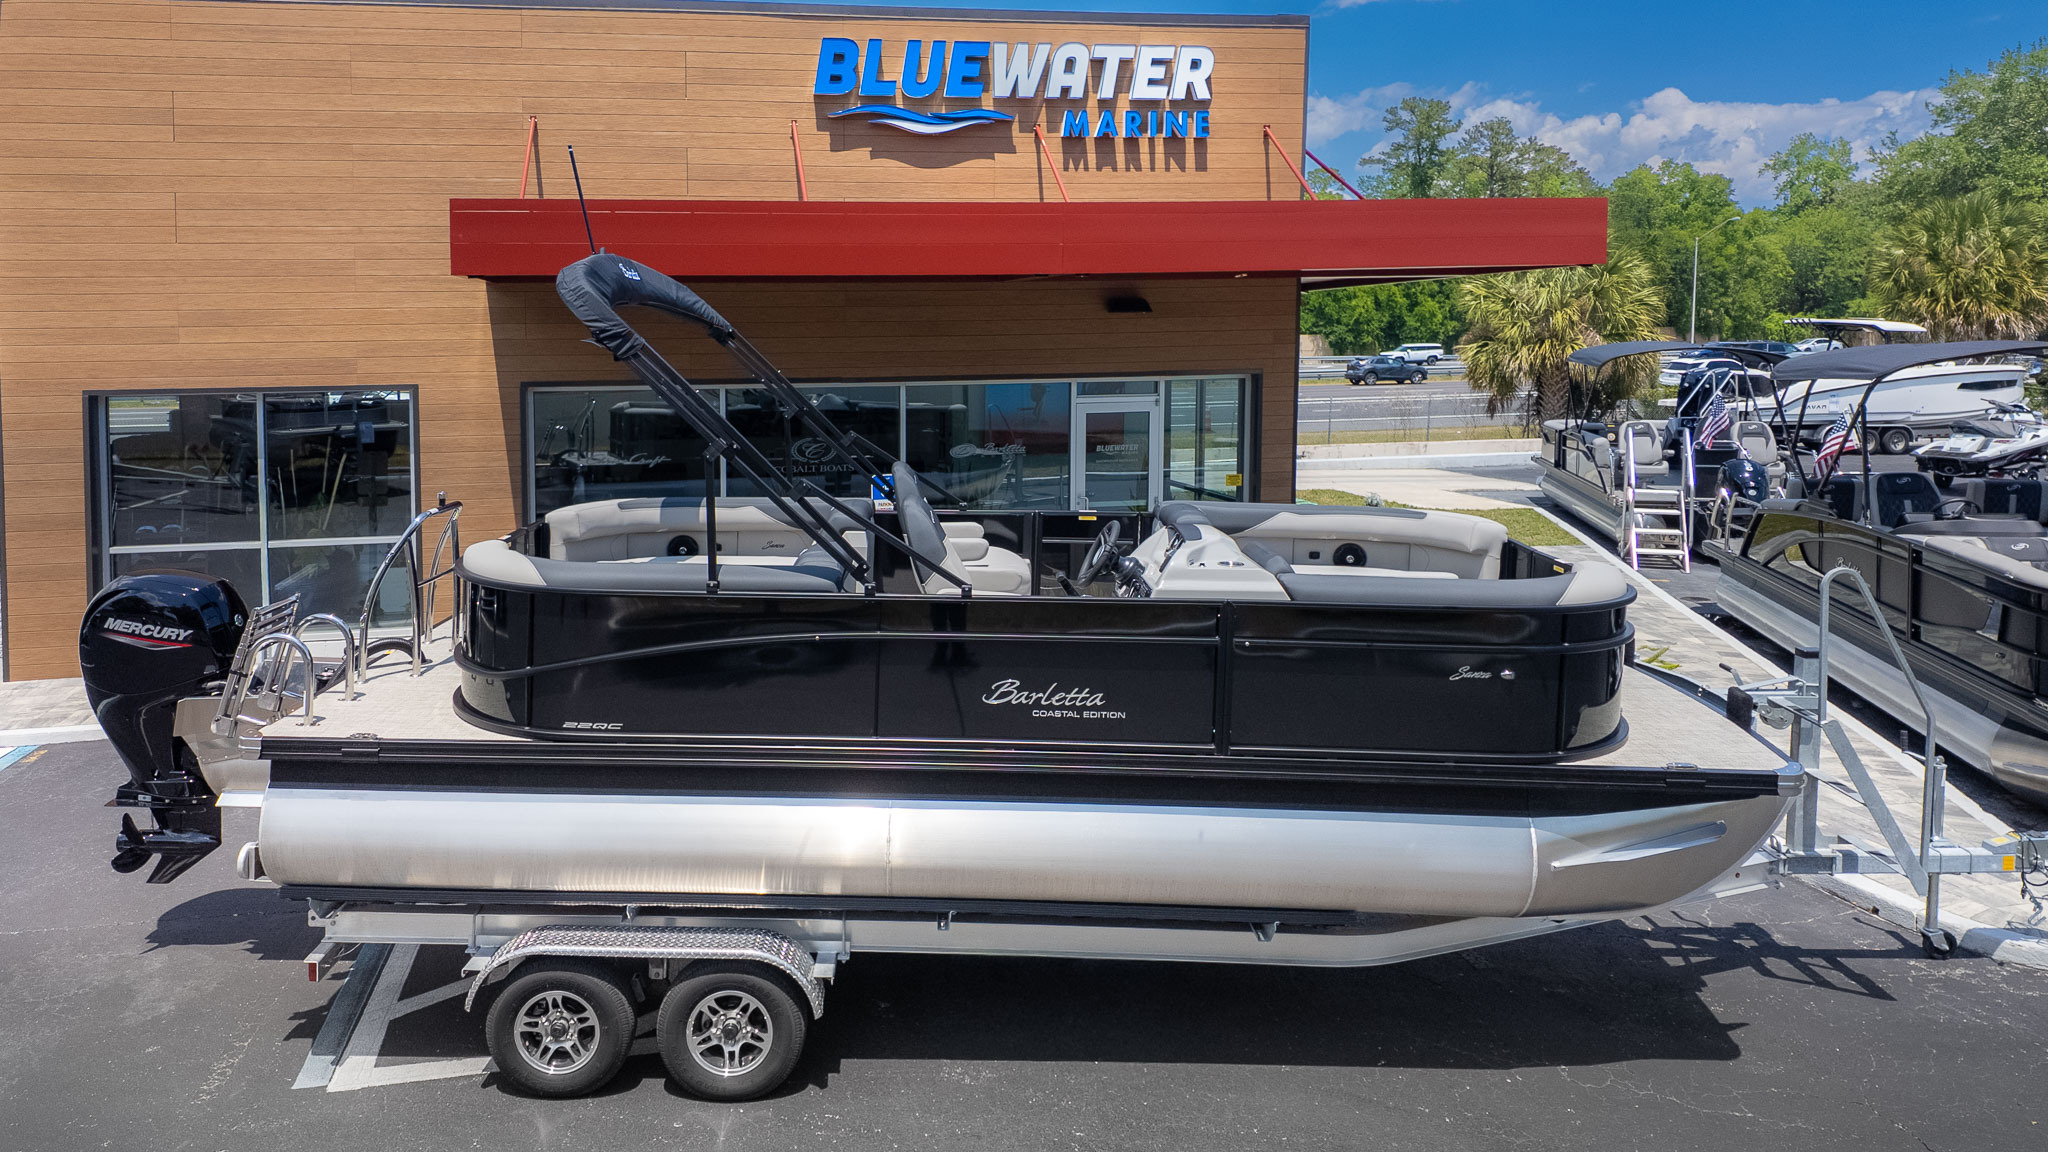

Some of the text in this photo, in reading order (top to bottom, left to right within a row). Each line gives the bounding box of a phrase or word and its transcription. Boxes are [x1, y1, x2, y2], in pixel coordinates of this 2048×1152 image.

[813, 37, 1215, 100] BLUEWATER
[1061, 109, 1210, 139] MARINE
[820, 463, 855, 473] BOATS
[103, 617, 194, 641] MERCURY
[982, 678, 1106, 707] Barletta
[562, 721, 624, 730] 22QC
[1032, 709, 1126, 719] COASTAL EDITION
